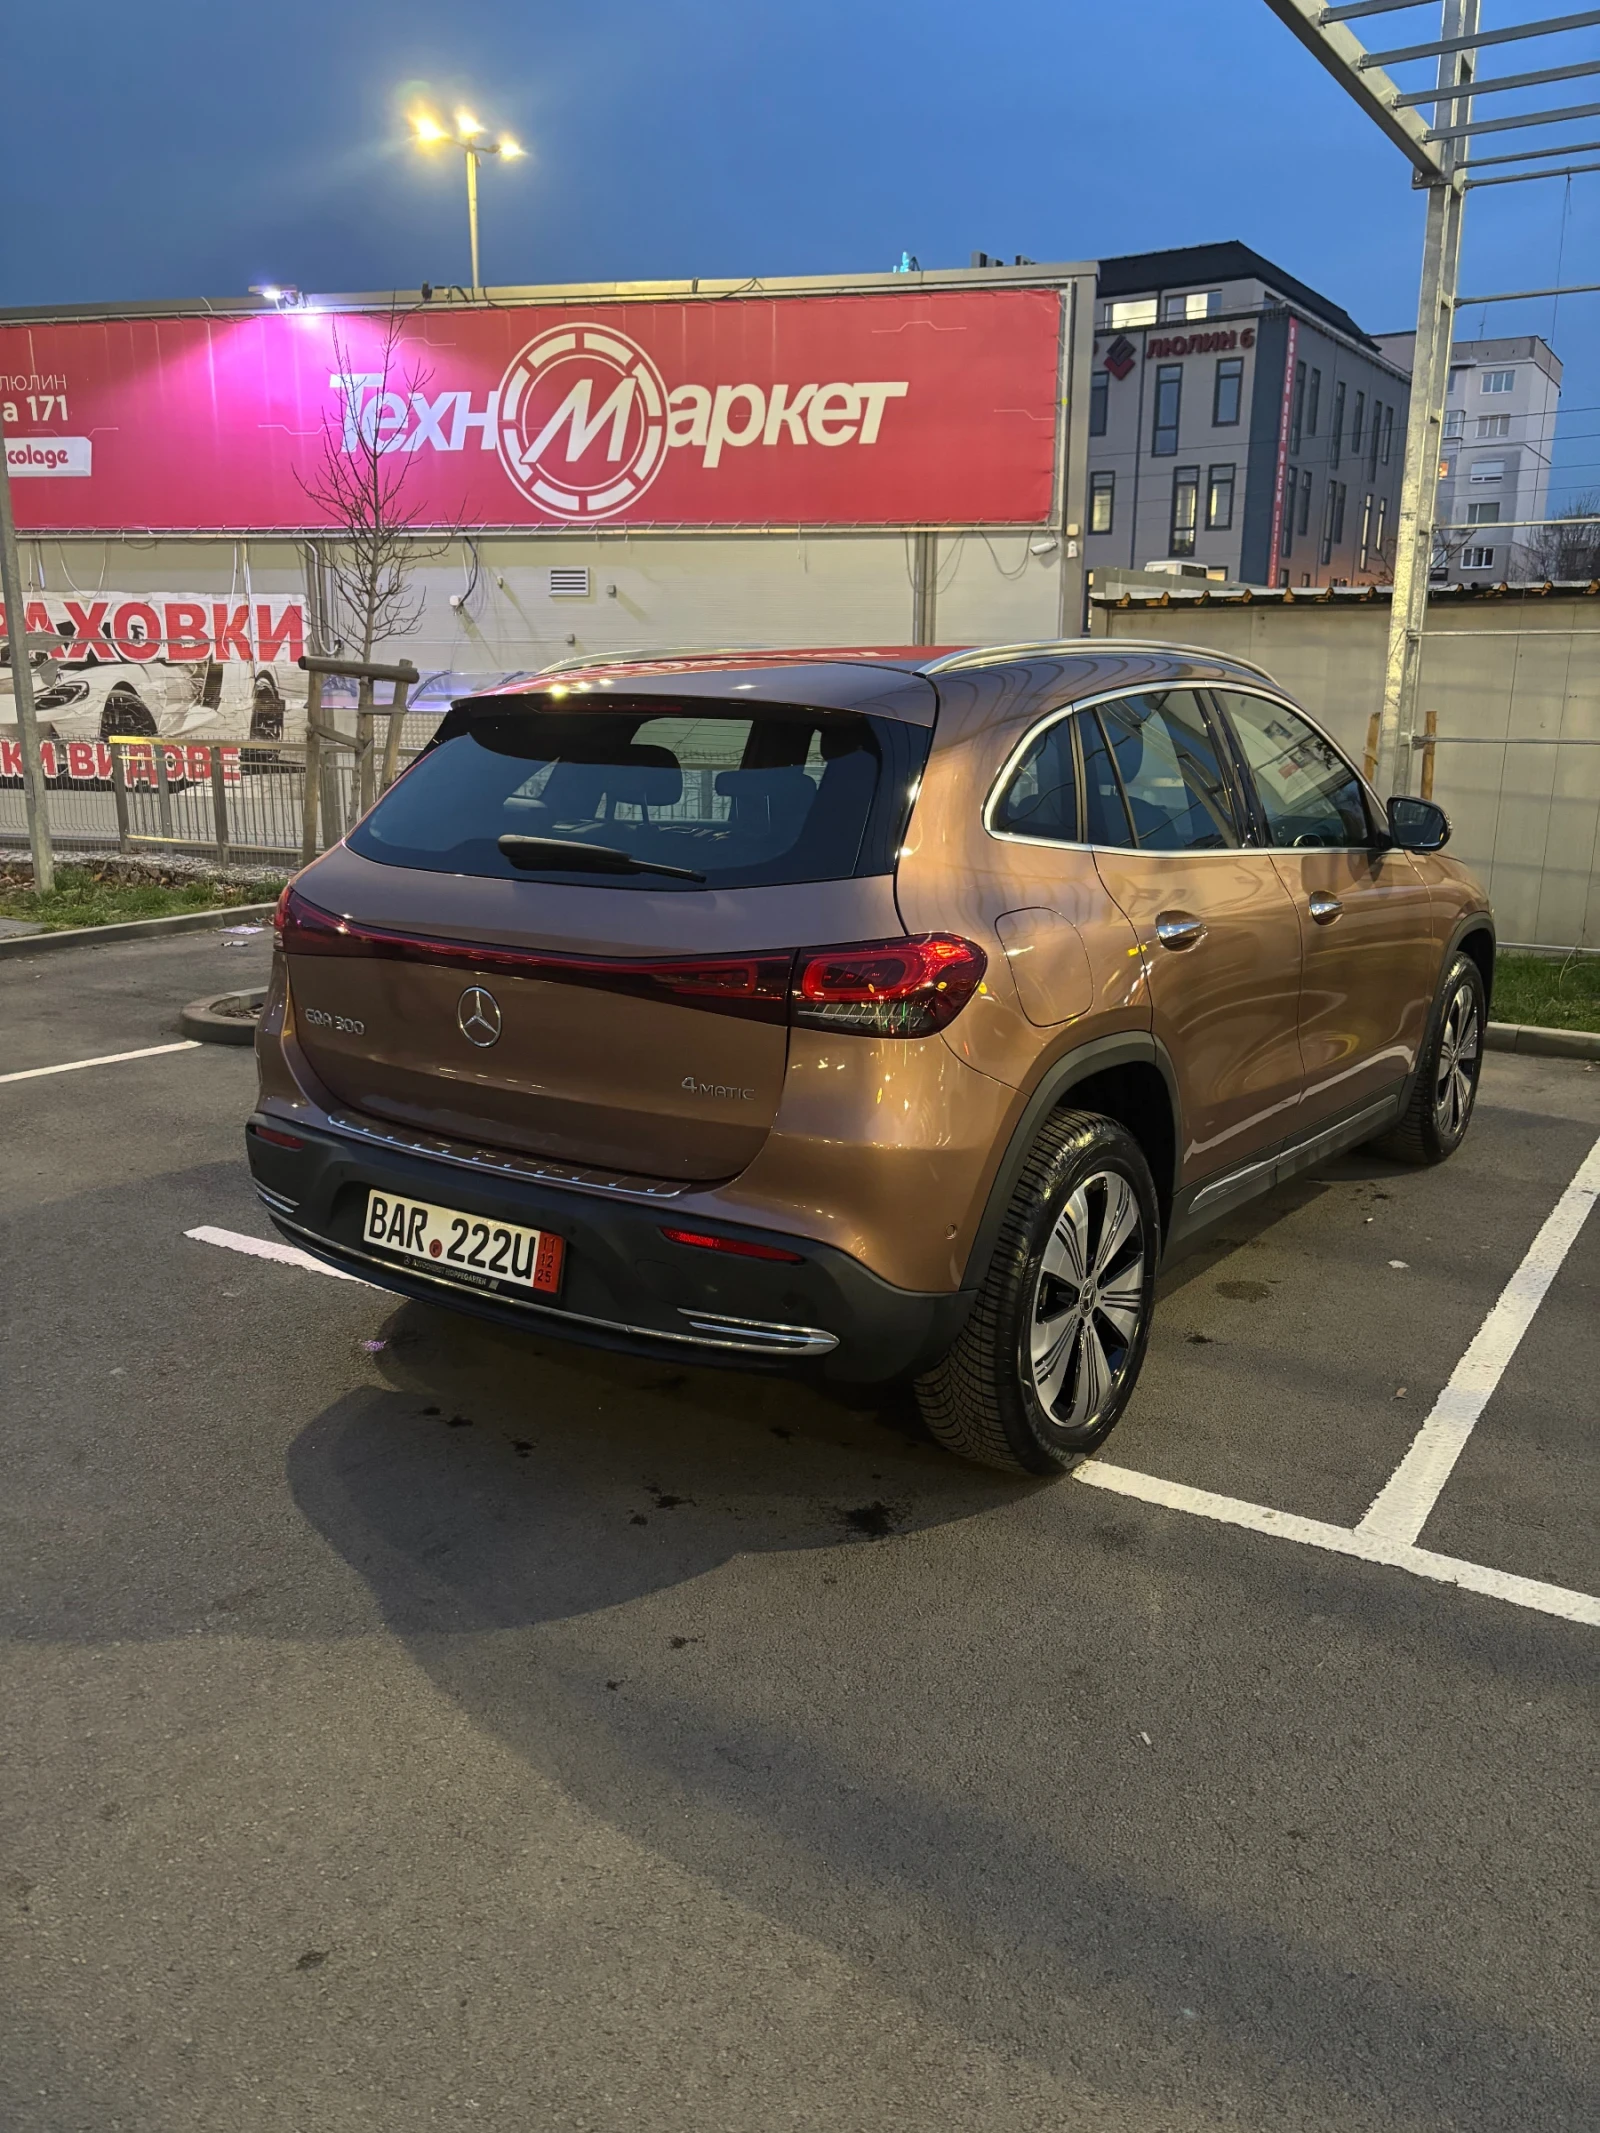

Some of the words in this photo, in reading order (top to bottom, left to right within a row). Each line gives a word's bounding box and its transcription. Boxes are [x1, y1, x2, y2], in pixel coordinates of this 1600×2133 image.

[1146, 330, 1237, 360] ЛЮЛИН
[1239, 328, 1256, 349] 6
[26, 395, 68, 421] 171
[335, 1015, 365, 1035] 300
[369, 1196, 428, 1252] BAR
[446, 1217, 536, 1280] 222U
[541, 1253, 554, 1268] 12
